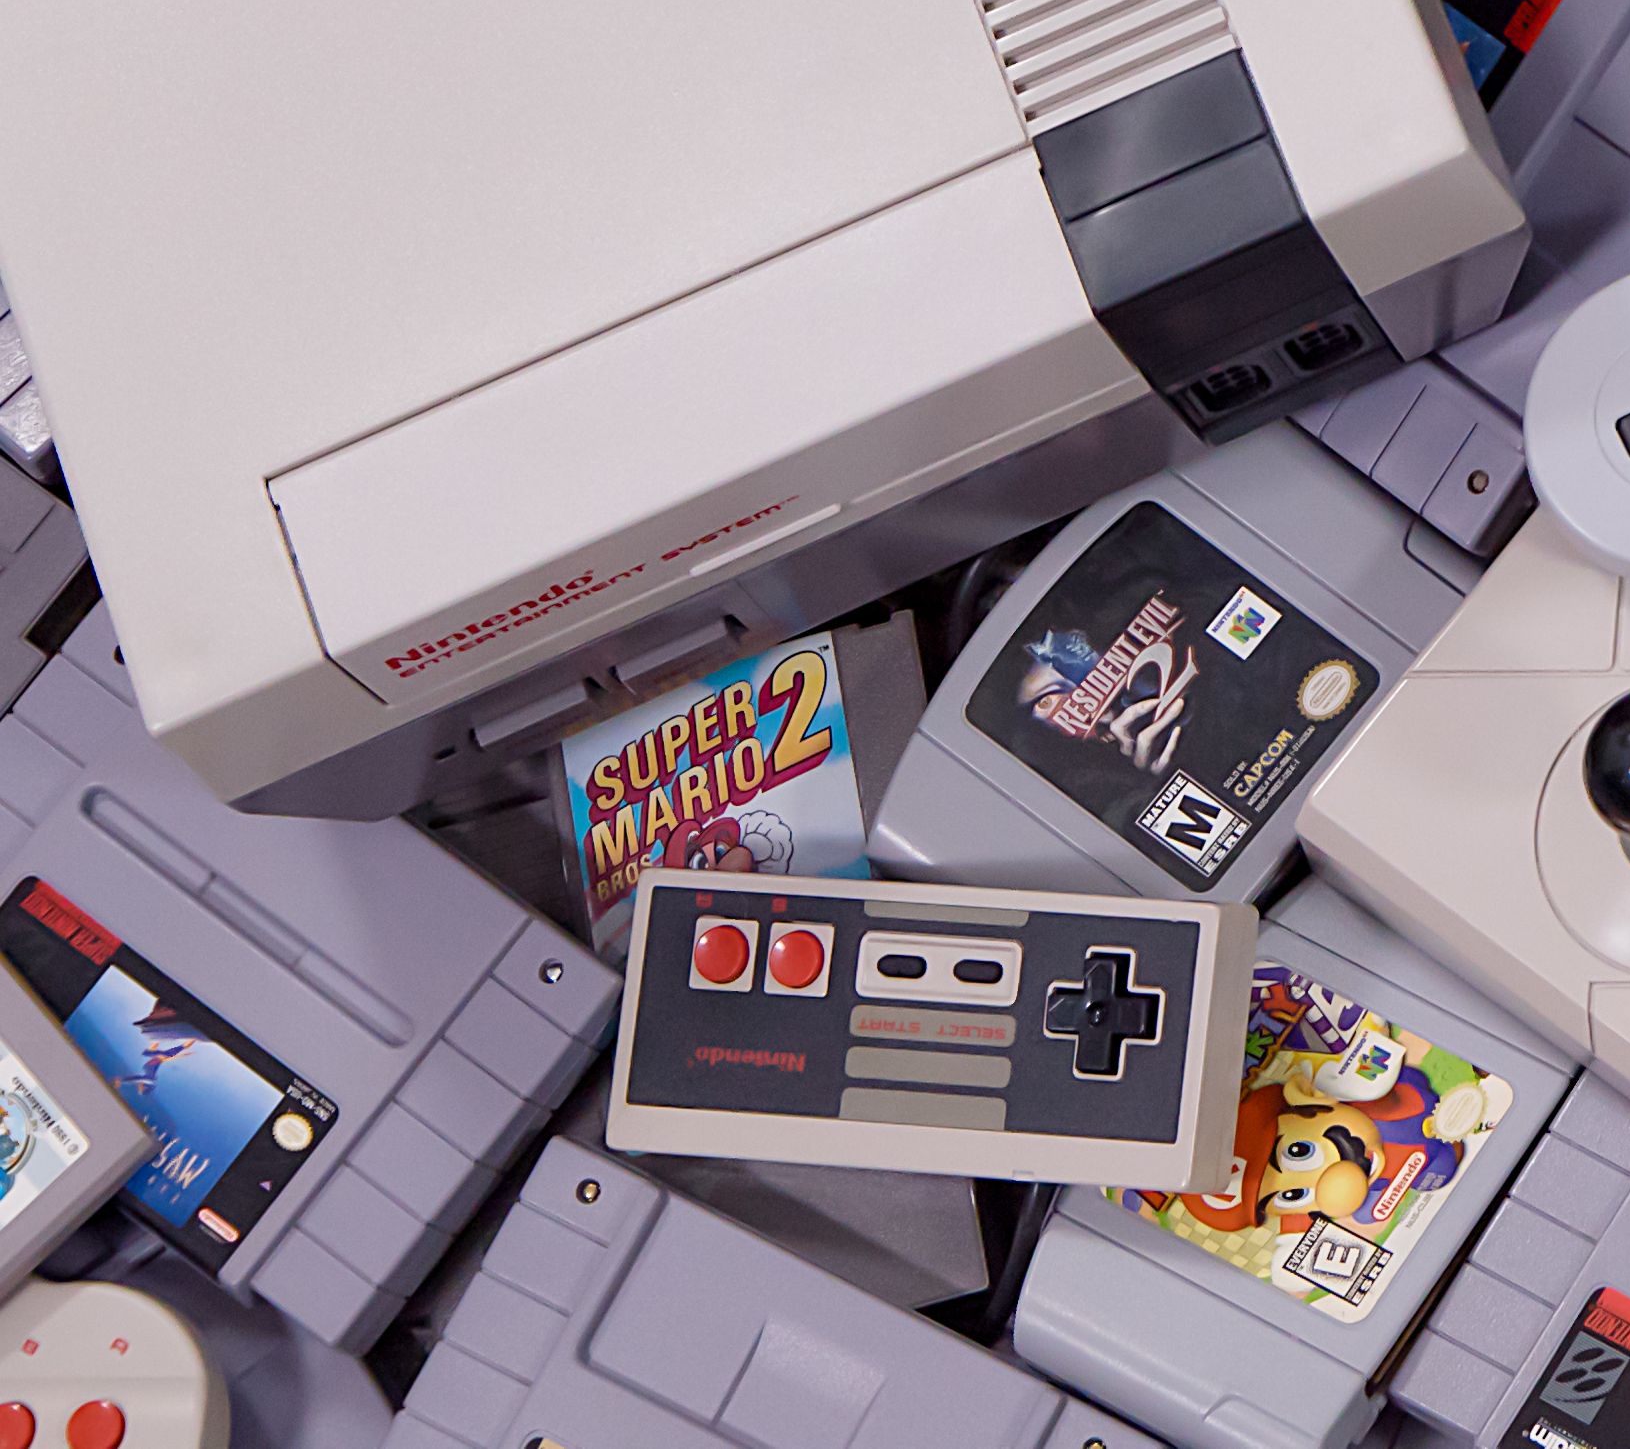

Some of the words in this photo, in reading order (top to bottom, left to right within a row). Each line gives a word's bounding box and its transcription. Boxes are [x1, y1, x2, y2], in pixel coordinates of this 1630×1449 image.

[399, 563, 647, 678] ENTERTAINMENT
[661, 503, 783, 560] SYSTEM
[1051, 640, 1140, 739] RESIDENT
[1129, 592, 1179, 655] EVIL
[588, 677, 757, 814] SUPER
[764, 650, 832, 780] 2
[1233, 728, 1293, 797] CAPCOM
[590, 739, 765, 879] MARIO
[1141, 776, 1187, 827] MATURE
[1376, 1156, 1423, 1219] Nintendo
[1284, 1222, 1327, 1274] EVERYONE
